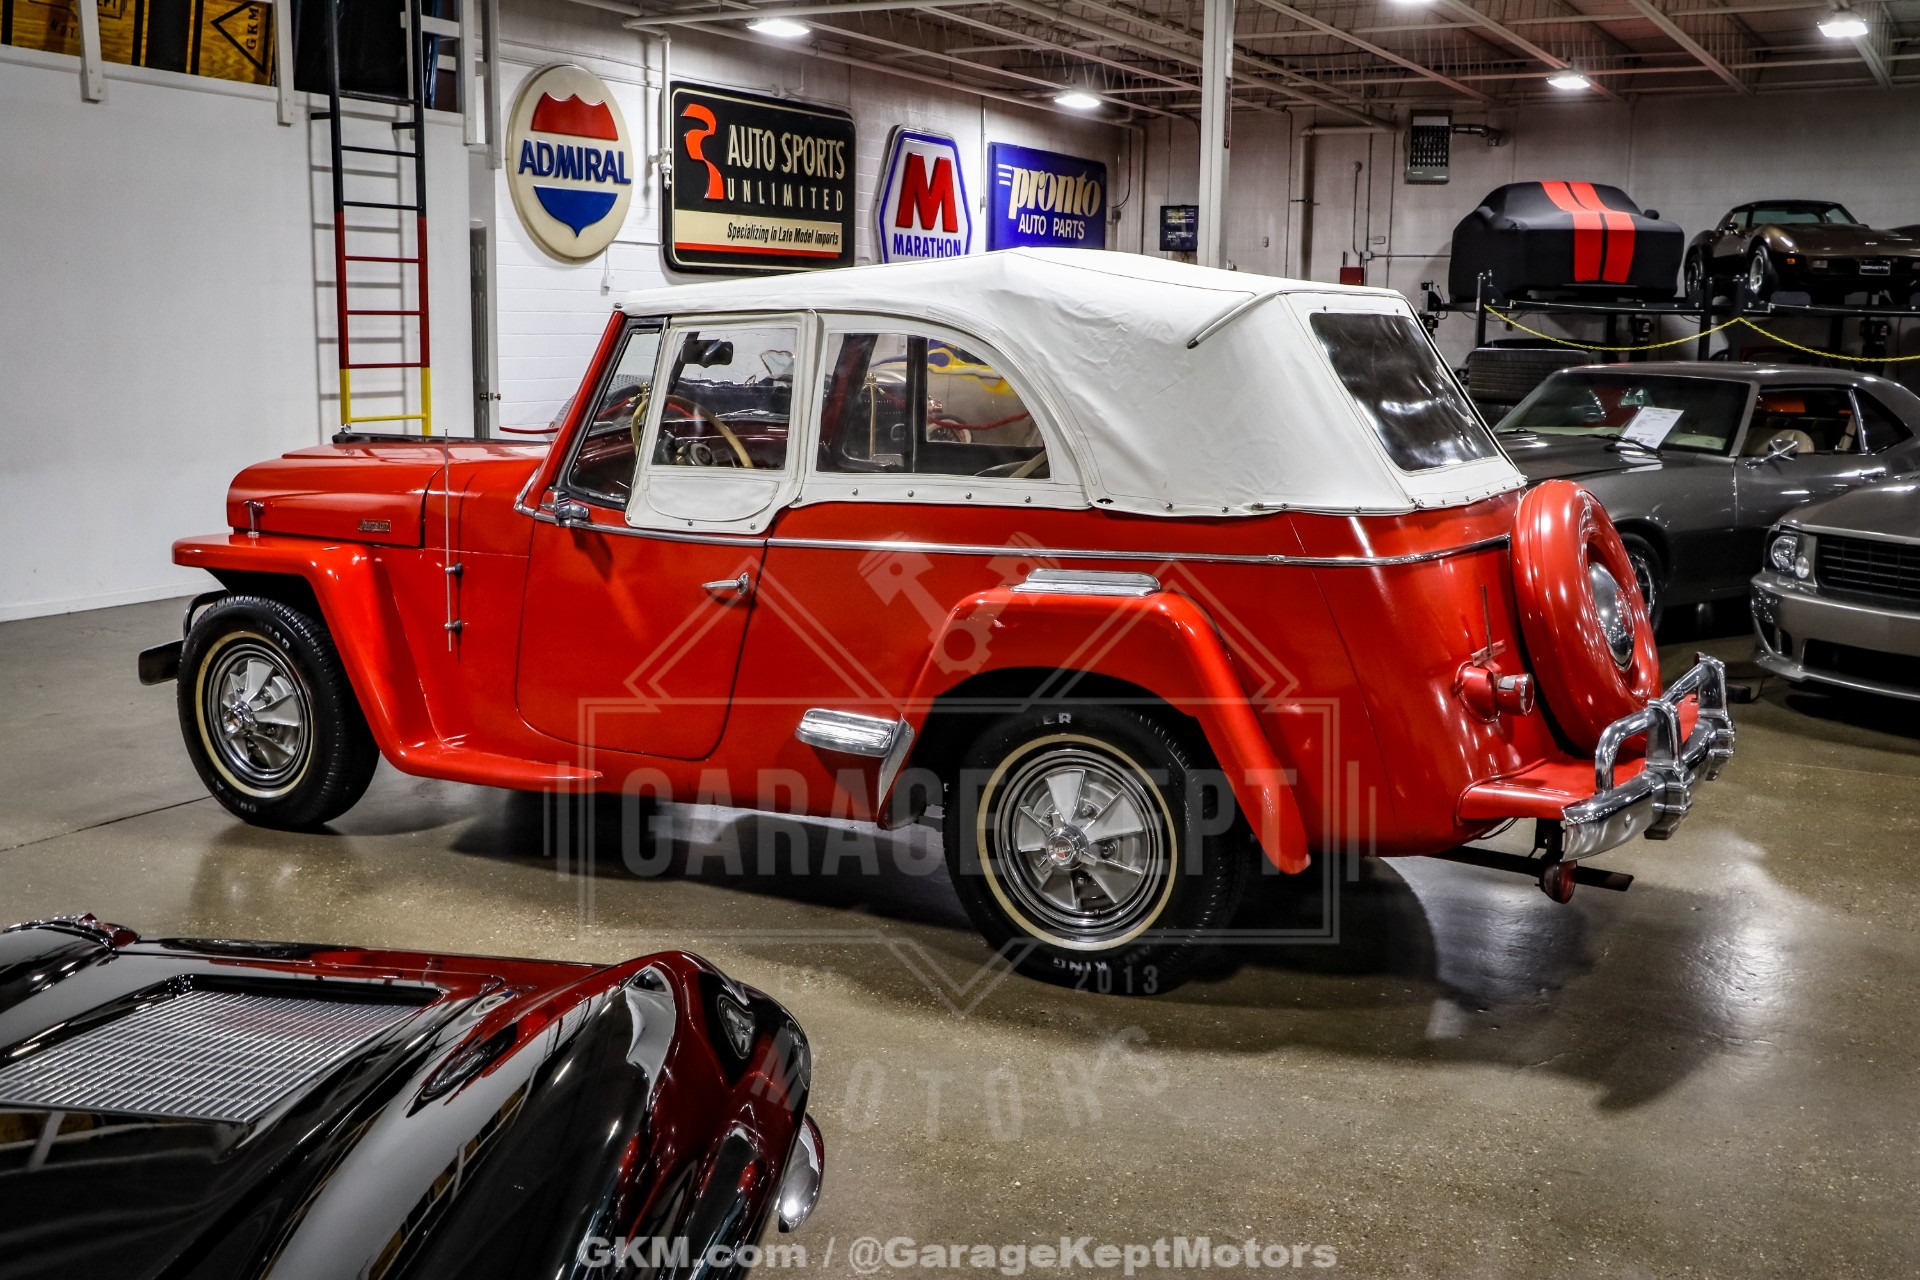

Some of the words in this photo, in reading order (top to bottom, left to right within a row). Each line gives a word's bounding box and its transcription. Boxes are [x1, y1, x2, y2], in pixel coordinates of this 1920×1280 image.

[245, 7, 260, 50] GKM
[517, 138, 632, 185] ADMIRAL
[727, 124, 776, 172] AUTO
[780, 132, 846, 181] SPORTS
[727, 177, 844, 212] UNLIMITED
[895, 151, 959, 233] M
[1007, 165, 1101, 220] pronto
[727, 221, 770, 243] Specializing
[778, 226, 793, 242] Late
[793, 227, 814, 244] Model
[814, 229, 839, 247] Imports
[893, 232, 962, 258] MARATHON
[1018, 213, 1047, 235] AUTO
[1052, 218, 1085, 240] PARTS
